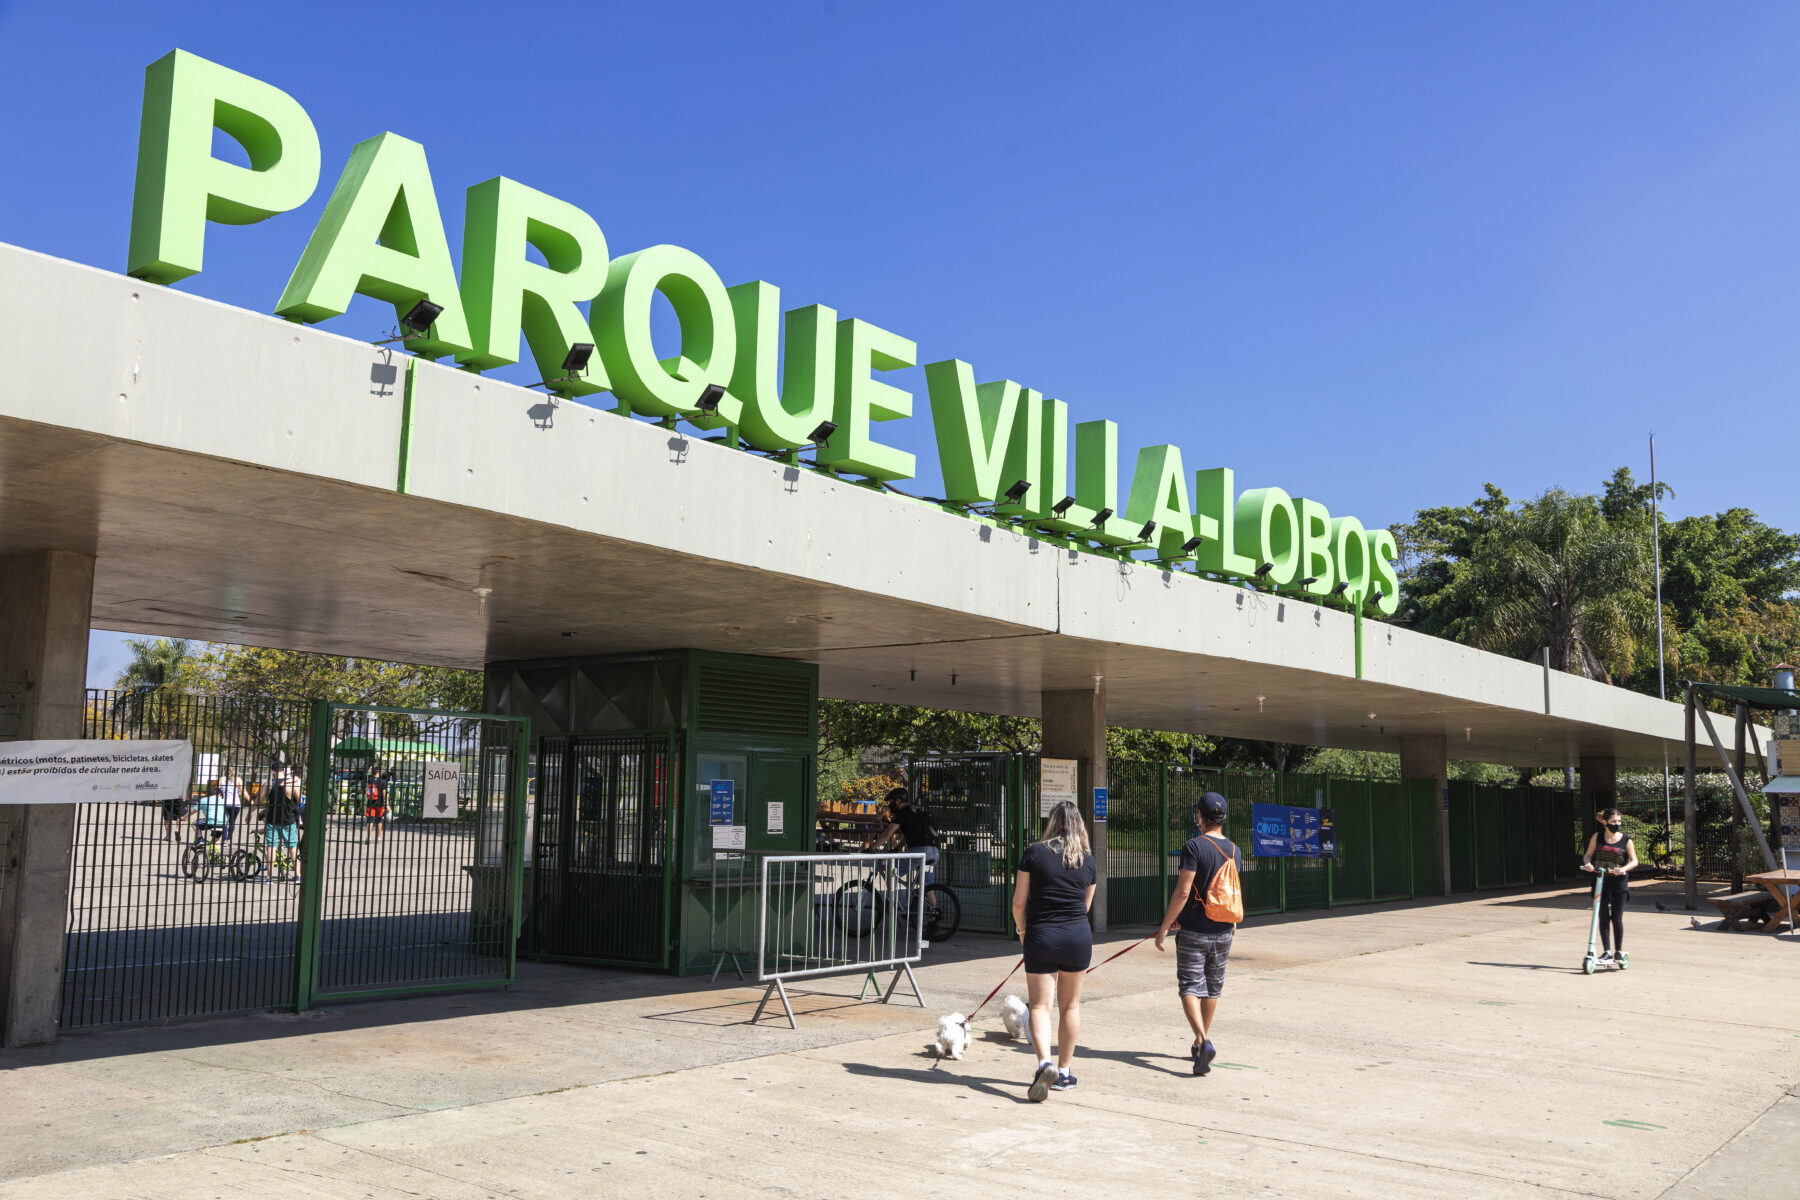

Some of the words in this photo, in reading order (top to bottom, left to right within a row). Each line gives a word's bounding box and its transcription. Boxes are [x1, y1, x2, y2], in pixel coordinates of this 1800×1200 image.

[127, 47, 918, 482] PARQUE
[924, 358, 1400, 615] VILLA-LOBOS
[0, 756, 34, 765] étricos
[35, 756, 69, 765] (motos,
[71, 755, 111, 765] patinetes,
[112, 754, 149, 763] bicicletas,
[151, 754, 174, 762] skates
[7, 767, 32, 776] estão
[33, 766, 77, 776] proibidos
[79, 766, 90, 774] de
[90, 766, 120, 774] circular
[121, 766, 140, 774] nesta
[141, 765, 161, 773] área.
[427, 768, 458, 780] SAÍDA
